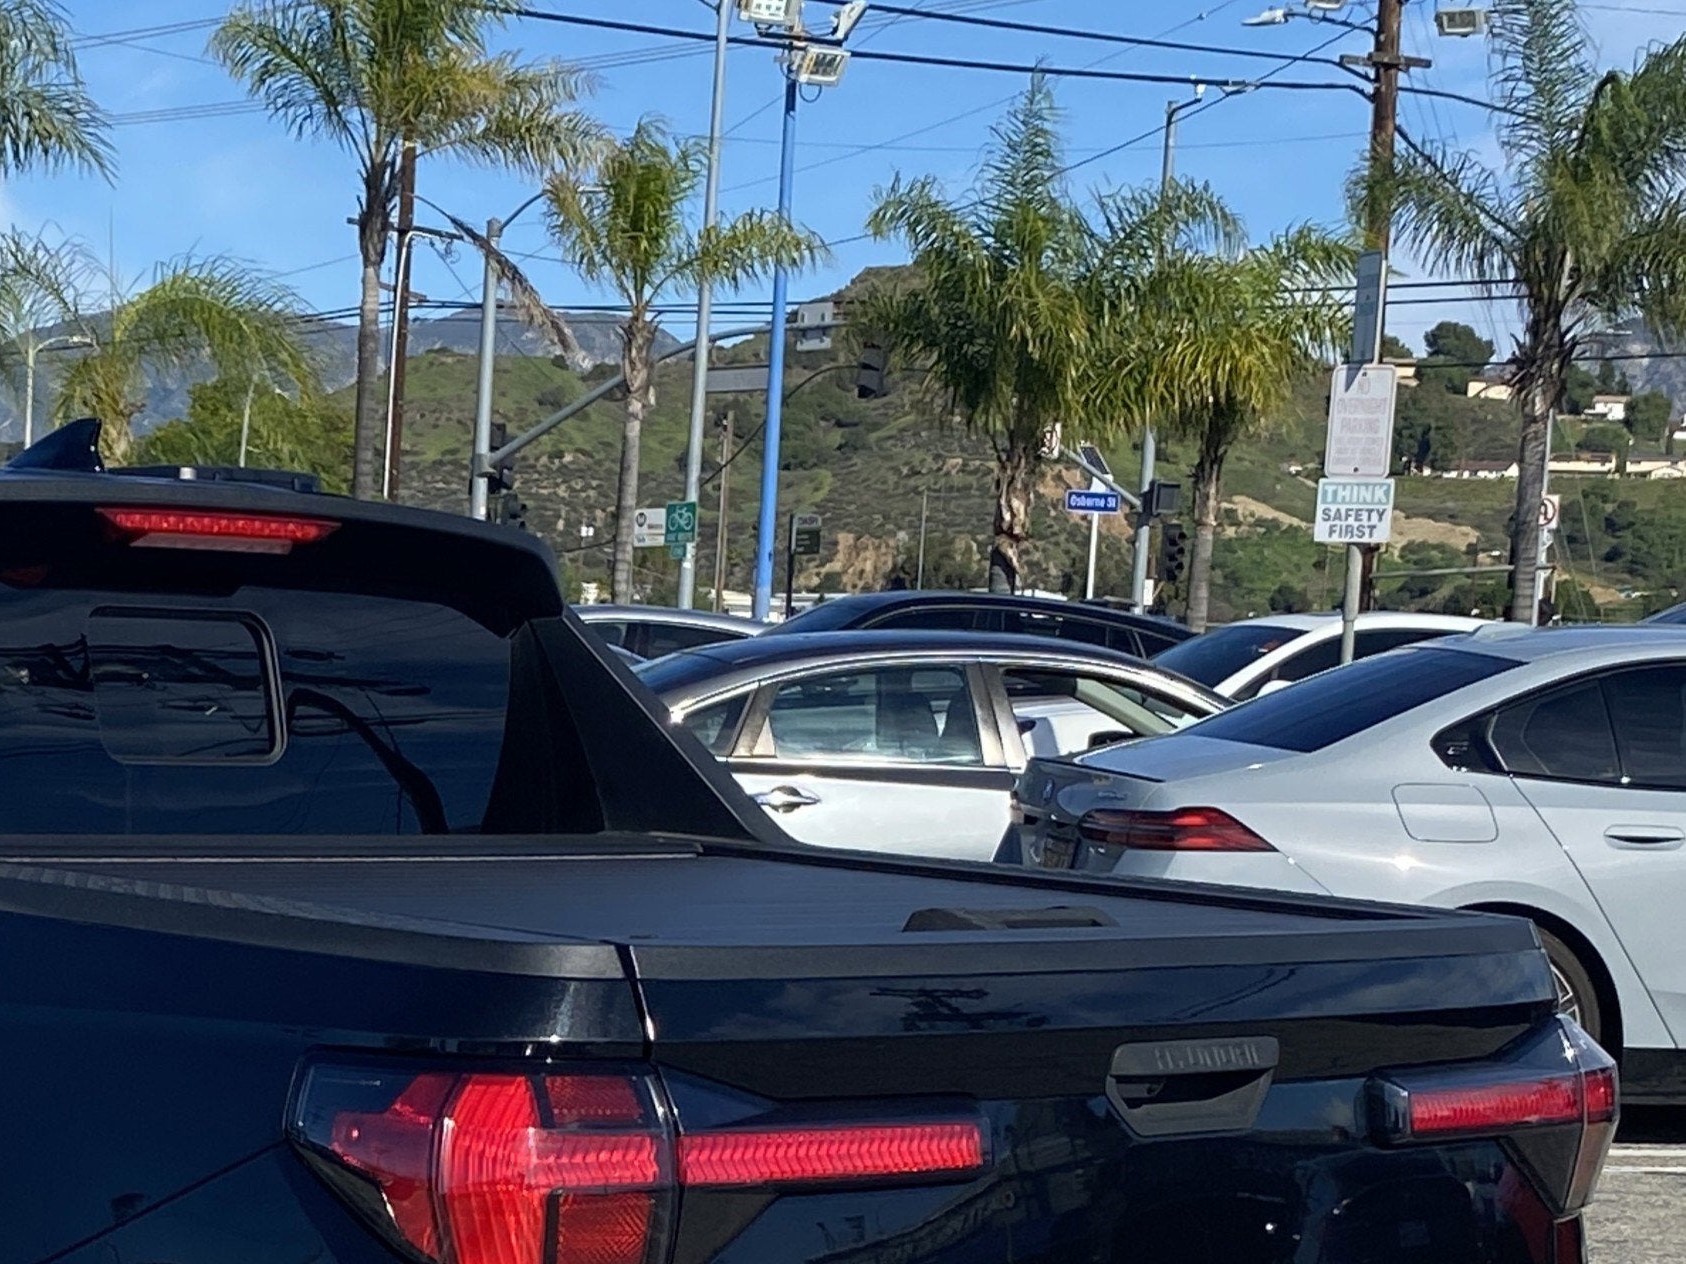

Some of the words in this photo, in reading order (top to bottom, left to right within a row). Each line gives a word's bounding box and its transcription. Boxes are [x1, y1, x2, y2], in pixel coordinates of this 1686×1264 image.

[1340, 417, 1380, 434] PARKING
[1070, 494, 1106, 507] Osborne
[1106, 496, 1116, 508] St
[1323, 484, 1388, 503] THINK
[1321, 507, 1387, 522] SAFETY
[1328, 524, 1377, 539] FIRST
